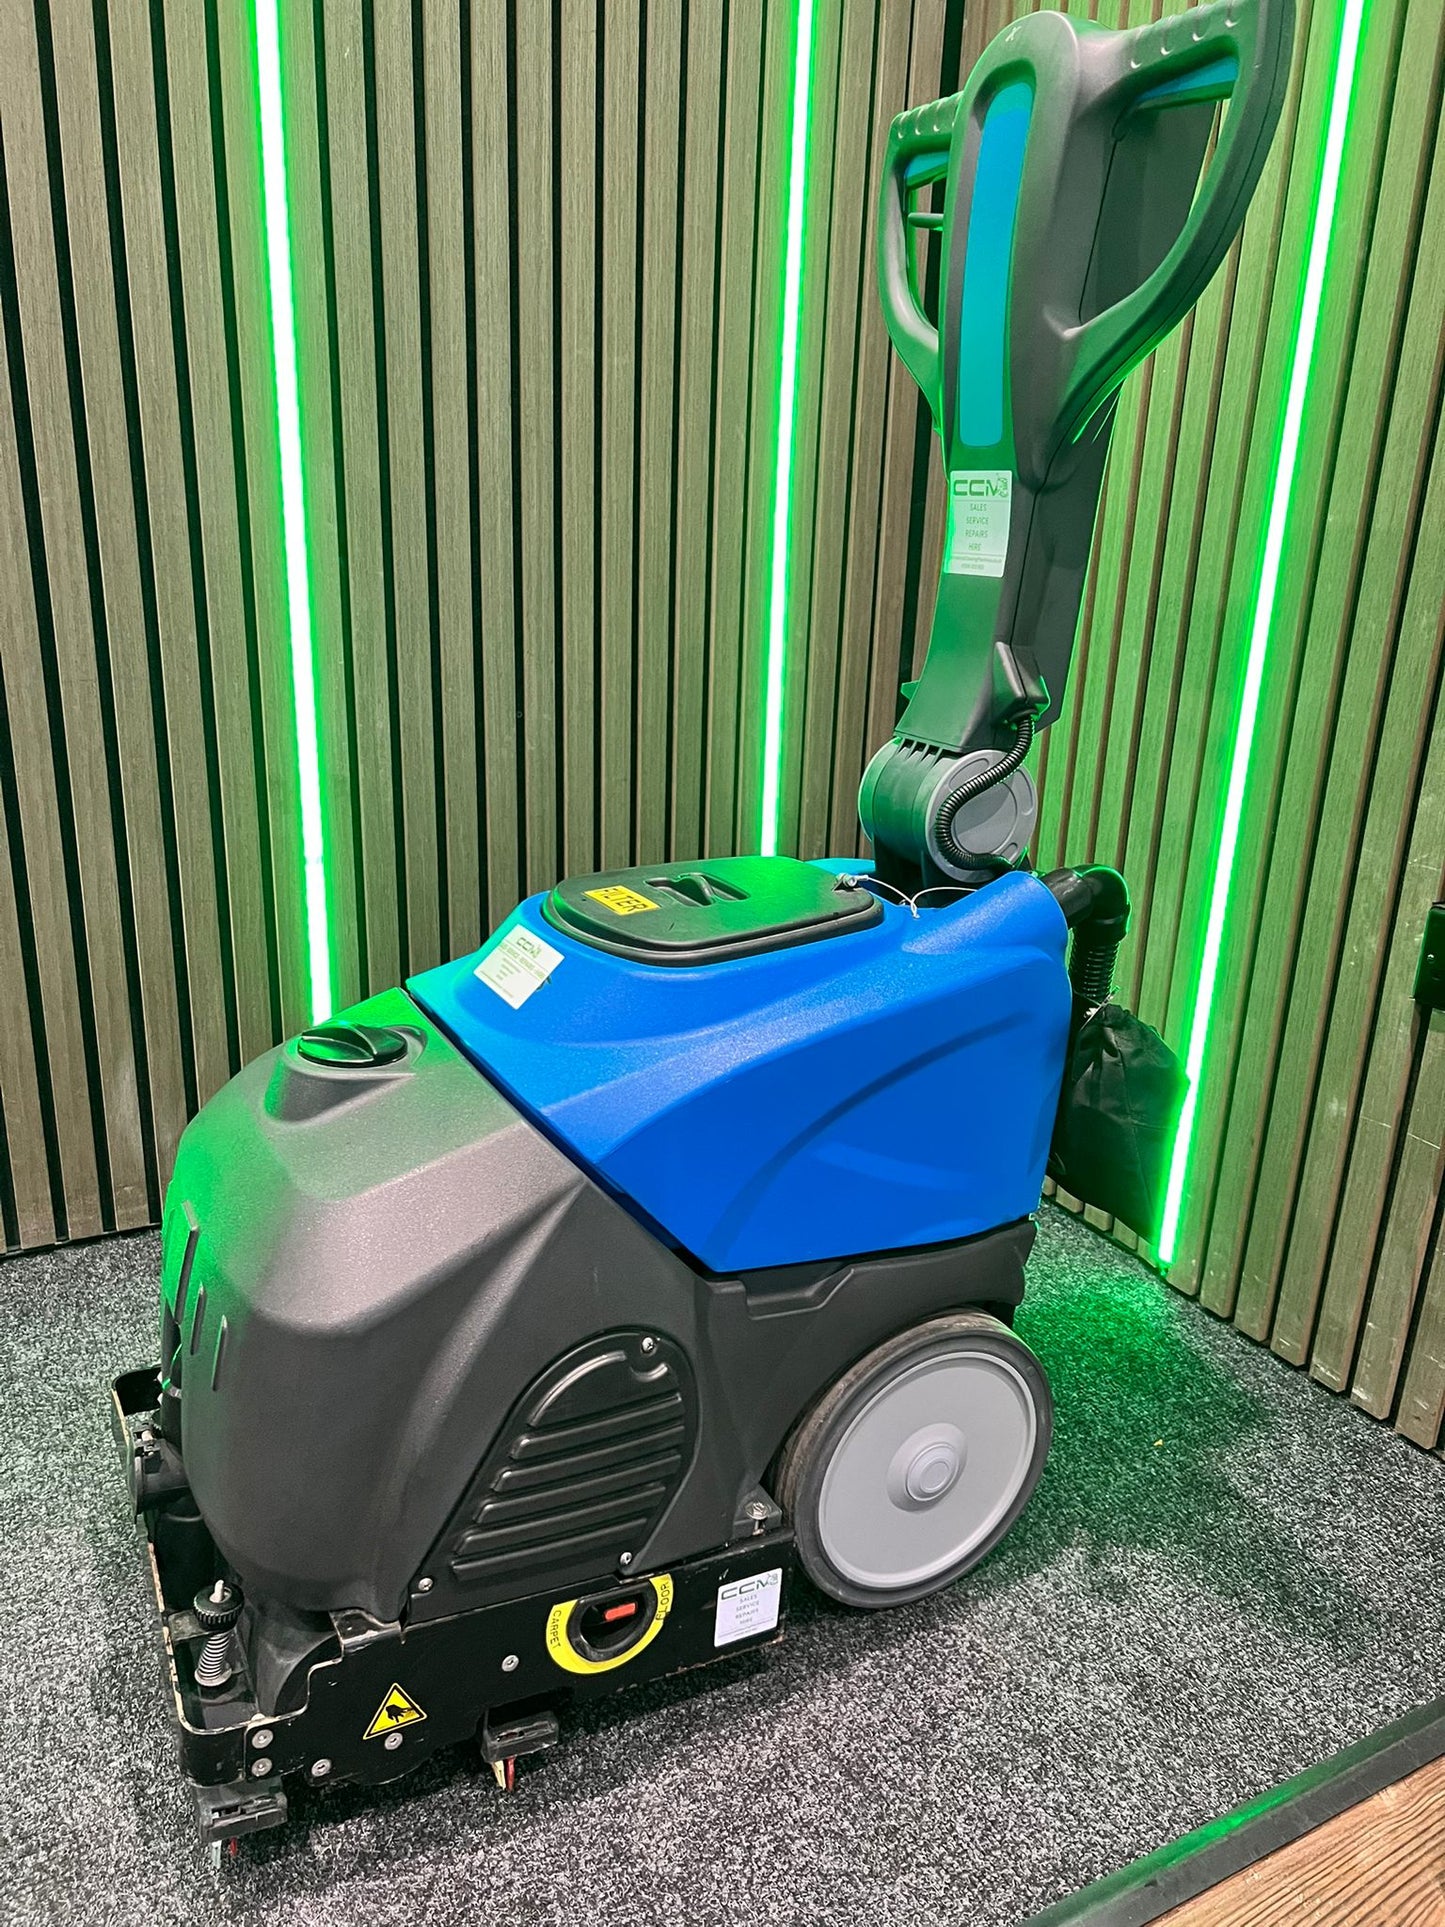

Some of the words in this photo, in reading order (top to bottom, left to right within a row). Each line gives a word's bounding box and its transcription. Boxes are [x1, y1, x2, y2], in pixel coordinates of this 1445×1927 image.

[970, 503, 987, 511] SALES
[966, 516, 989, 525] SERVICE
[965, 529, 988, 538] REPAIRS
[595, 888, 648, 912] FILTER
[655, 1581, 670, 1621] FLOOR
[740, 1594, 757, 1604] SALES
[736, 1600, 760, 1612] SERVICE
[550, 1610, 561, 1649] CARPET
